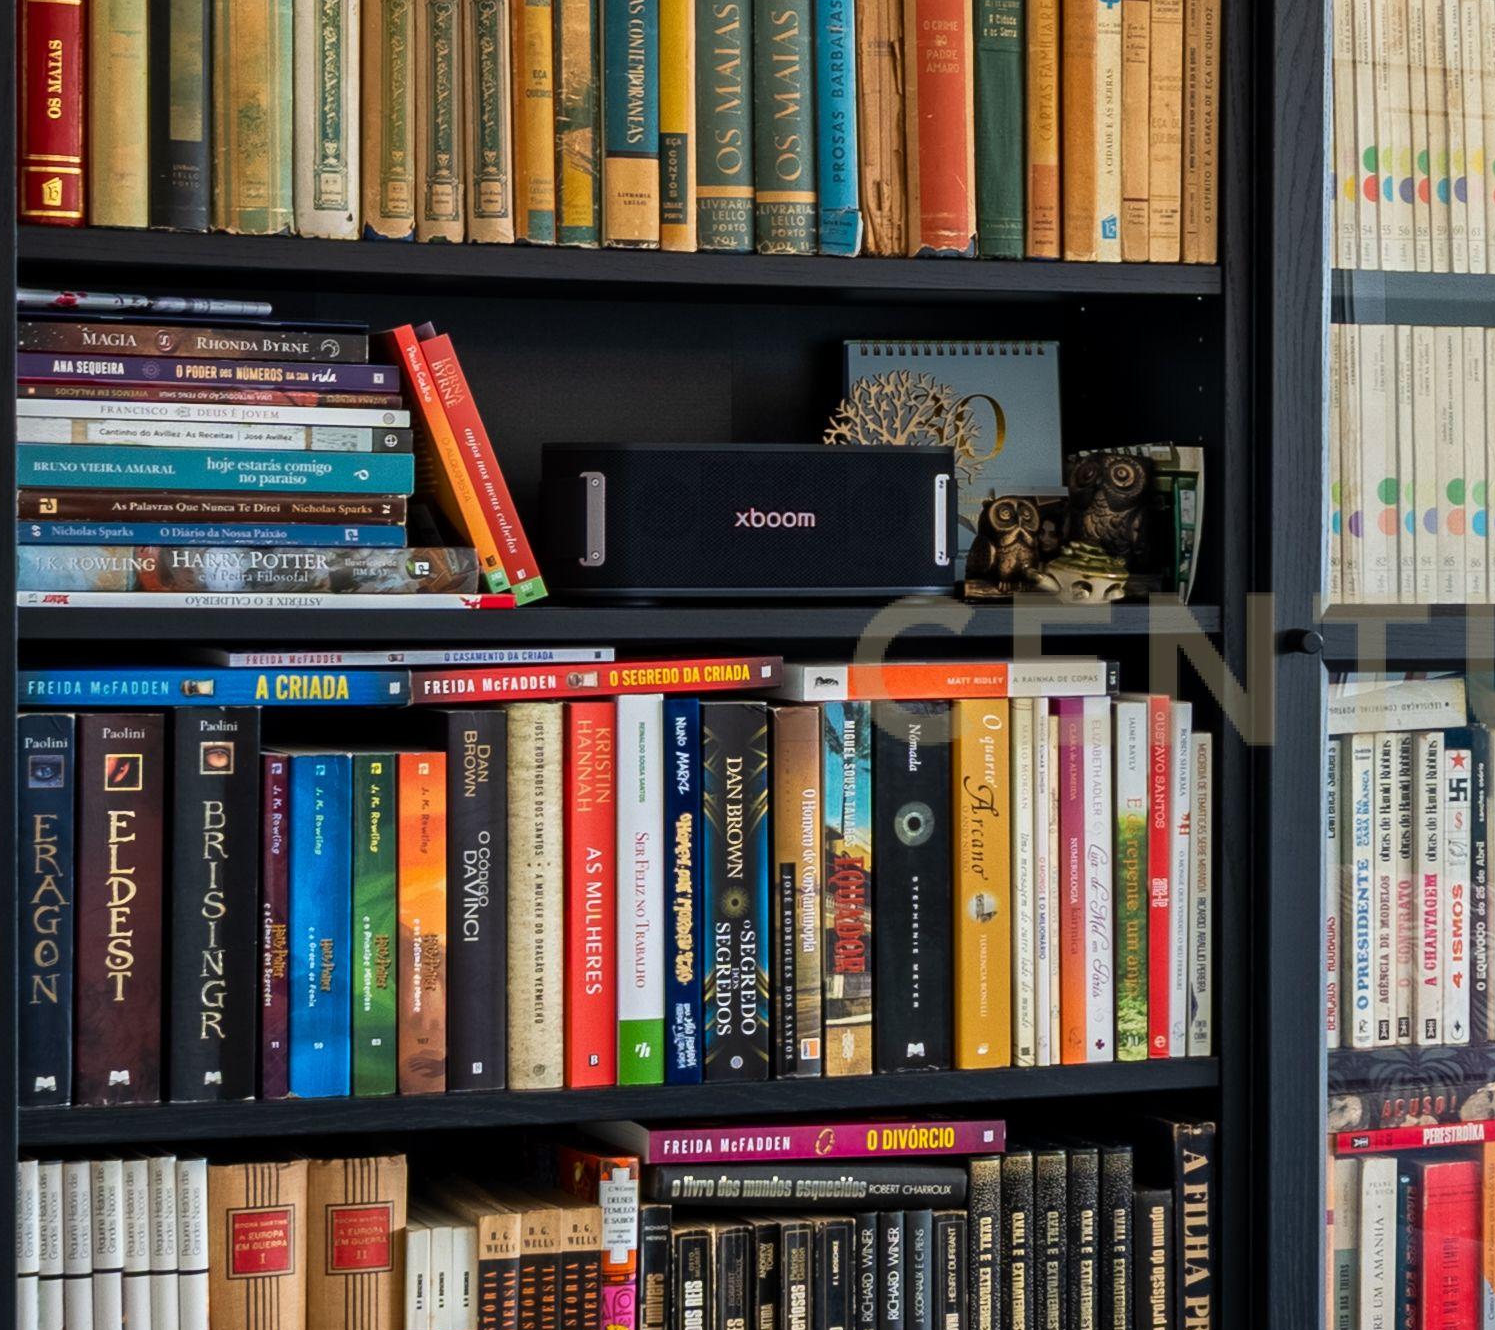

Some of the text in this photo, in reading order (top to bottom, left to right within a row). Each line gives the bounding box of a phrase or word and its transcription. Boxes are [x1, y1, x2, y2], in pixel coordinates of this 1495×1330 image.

[47, 38, 63, 119] OS MAIAS
[714, 4, 744, 176] OS MAIAS
[772, 9, 803, 182] OS MAIAS
[82, 333, 137, 347] MAGIA
[197, 337, 309, 354] RHONDA BYRNE
[53, 360, 124, 375] ANA SEQUEIRA
[432, 357, 464, 409] LORNA BYRNE
[34, 461, 175, 475] BRUNO VIEIRA AMARAL
[207, 457, 332, 474] hoje estarás comigo
[239, 472, 256, 483] no
[464, 428, 517, 554] anjos nos meus cabelos
[112, 502, 280, 513] As Palavras Que Nunca Te Direi
[292, 503, 372, 515] Nicholas Sparks
[735, 508, 816, 528] xboom
[35, 556, 156, 572] J.K. ROWLING
[172, 550, 329, 570] HARRY POTTER
[424, 676, 556, 695] FREIDA McFADDEN
[610, 664, 750, 687] O SEGREDO DA CRIADA
[947, 676, 1004, 686] MATT RIDLEY
[28, 681, 169, 695] FREIDA McFADDEN
[256, 675, 349, 700] A CRIADA
[102, 726, 146, 742] Paolini
[199, 719, 239, 734] Paolini
[24, 736, 69, 752] Paolini
[464, 730, 491, 797] DAN BROWN
[578, 720, 611, 813] KRISTIN HANNAH
[726, 757, 744, 879] DAN BROWN
[478, 831, 491, 907] O CÓDIGO
[30, 814, 70, 1005] ERAGON
[105, 810, 138, 1002] ELDEST
[200, 800, 228, 1040] BRISINGR
[585, 847, 602, 995] AS MULHERES
[715, 922, 732, 1036] SEGREDOS
[740, 931, 756, 1035] SEGREDO
[663, 1134, 791, 1155] FREIDA McFADDEN
[867, 1125, 955, 1151] O DIVÓRCIO
[1183, 1150, 1209, 1174] A
[1183, 1182, 1211, 1287] FILHA
